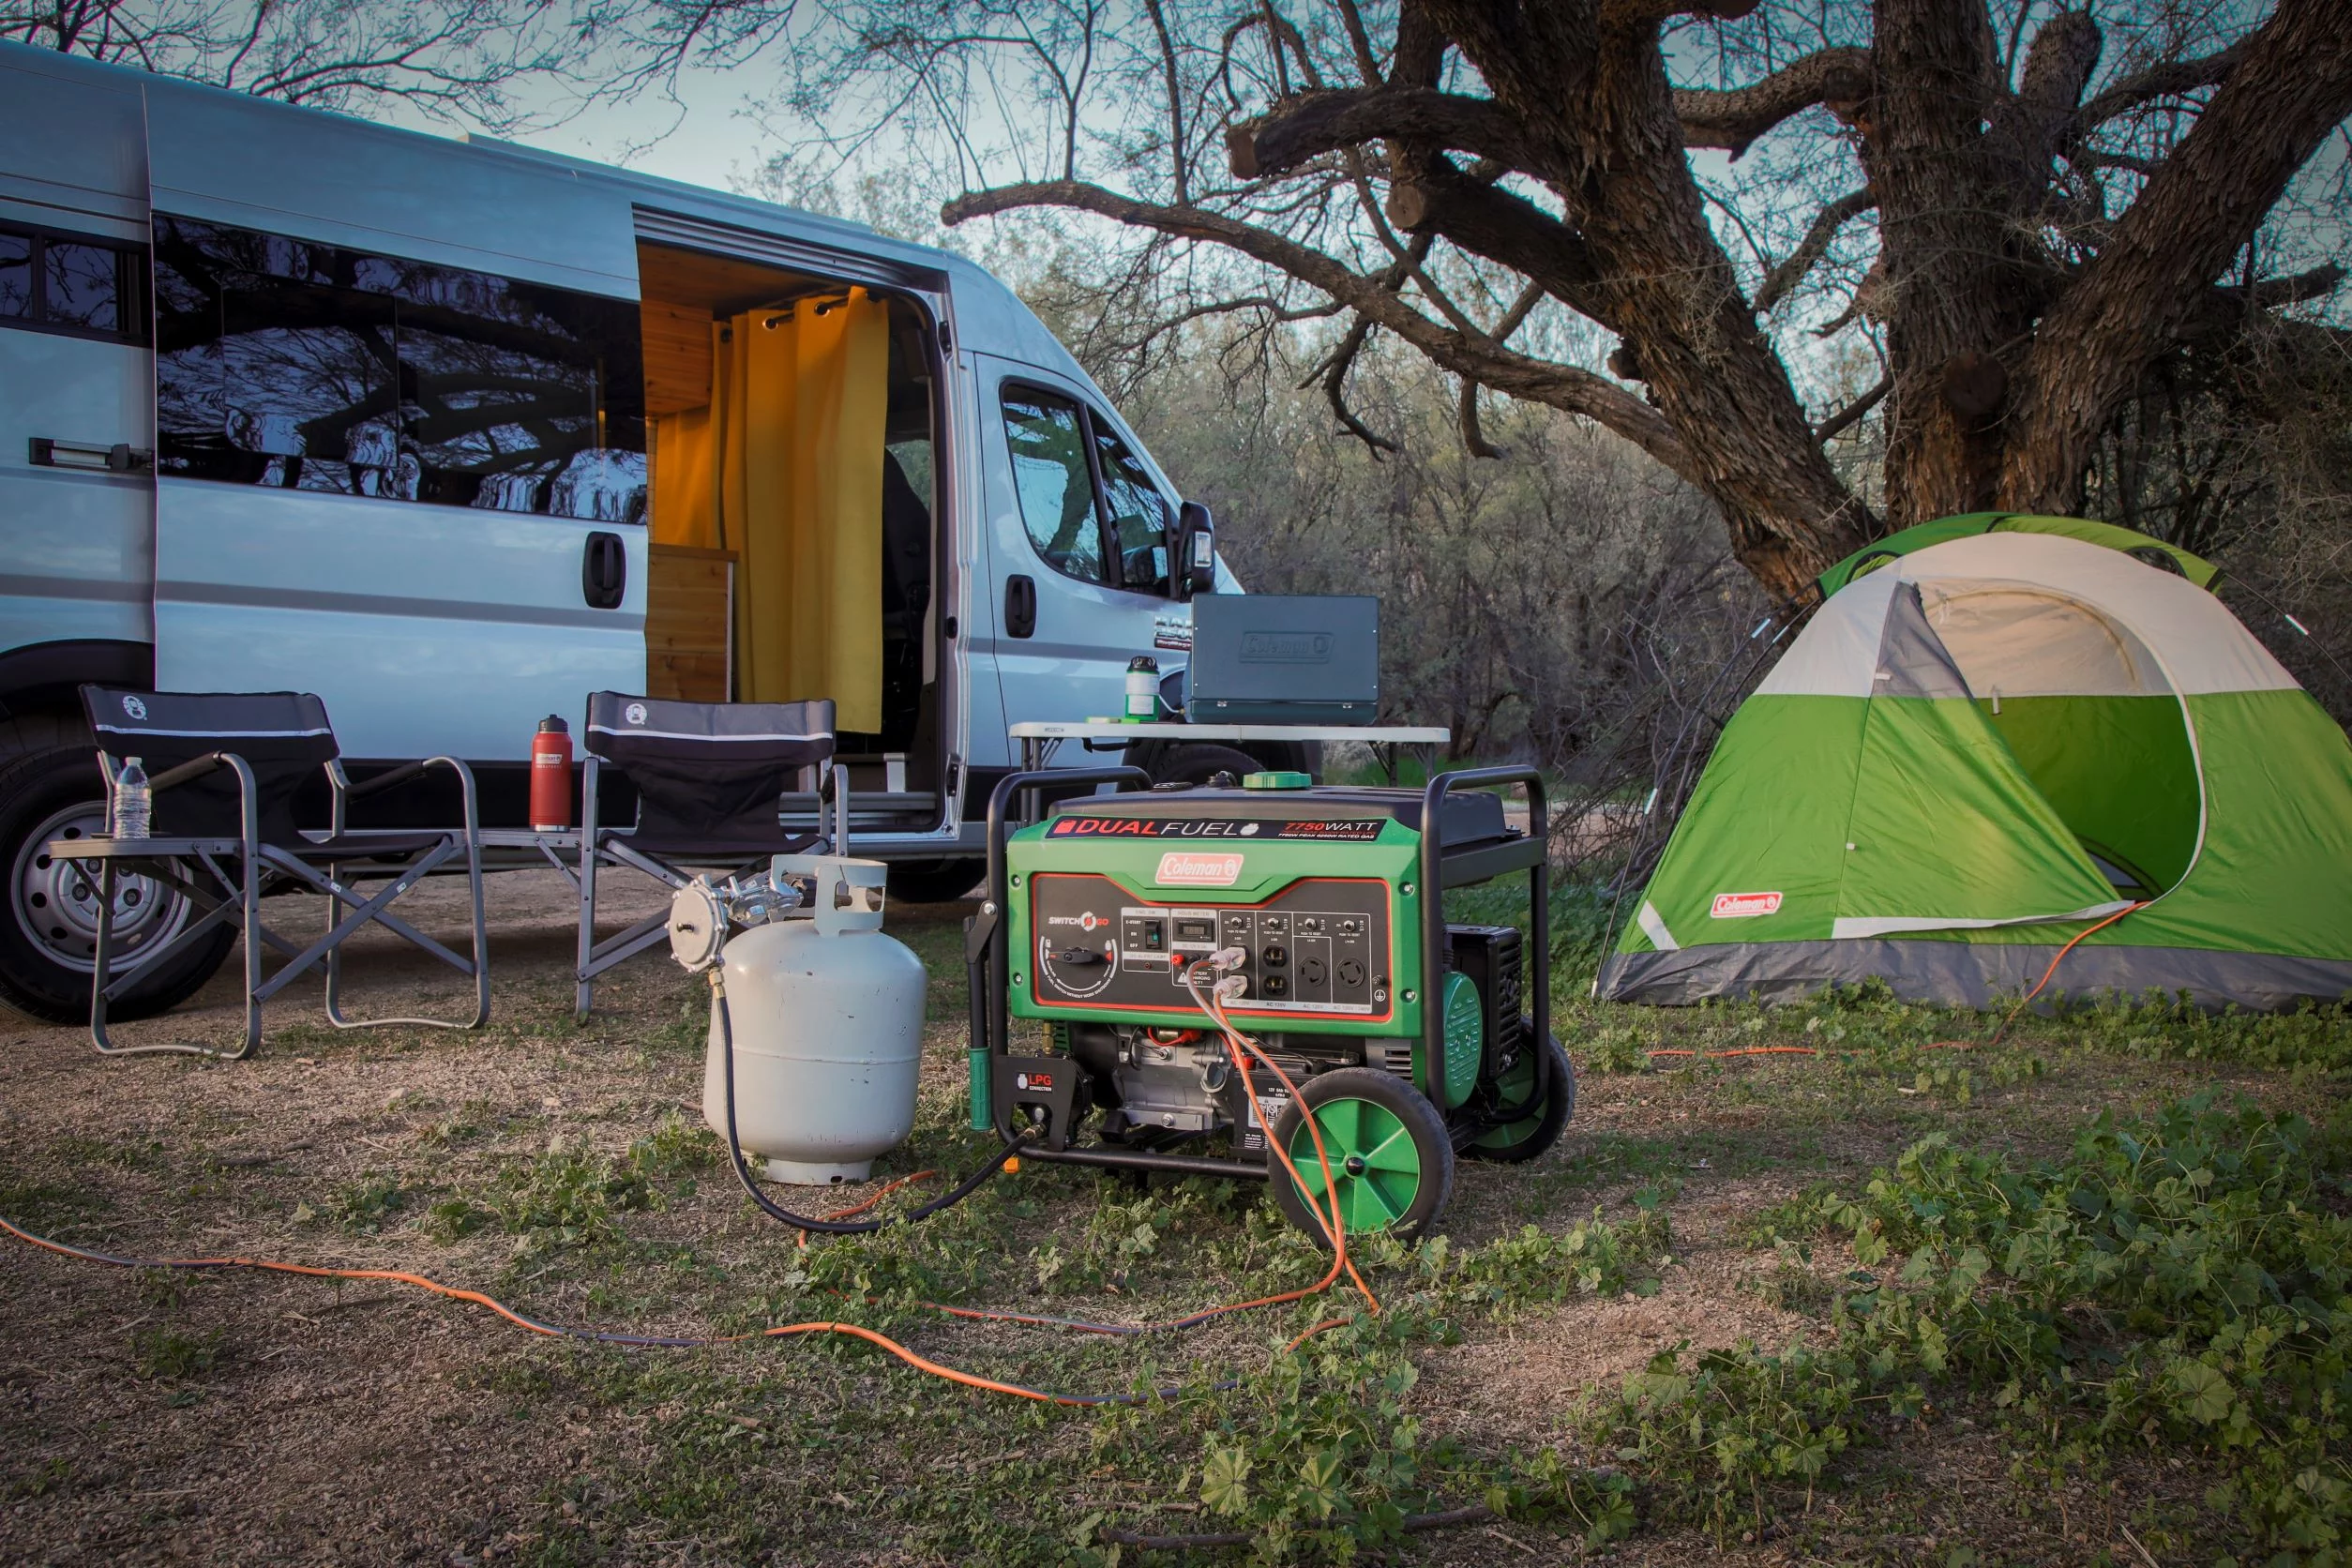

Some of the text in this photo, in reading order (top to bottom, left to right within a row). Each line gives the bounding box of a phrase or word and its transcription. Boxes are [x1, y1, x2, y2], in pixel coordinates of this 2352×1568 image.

[1247, 635, 1309, 654] Coleman
[1075, 820, 1238, 837] DUAL FUEL
[1164, 856, 1223, 876] Coleman
[1717, 897, 1766, 913] Coleman
[1048, 916, 1080, 926] SWITCH
[1029, 1074, 1051, 1086] LPG
